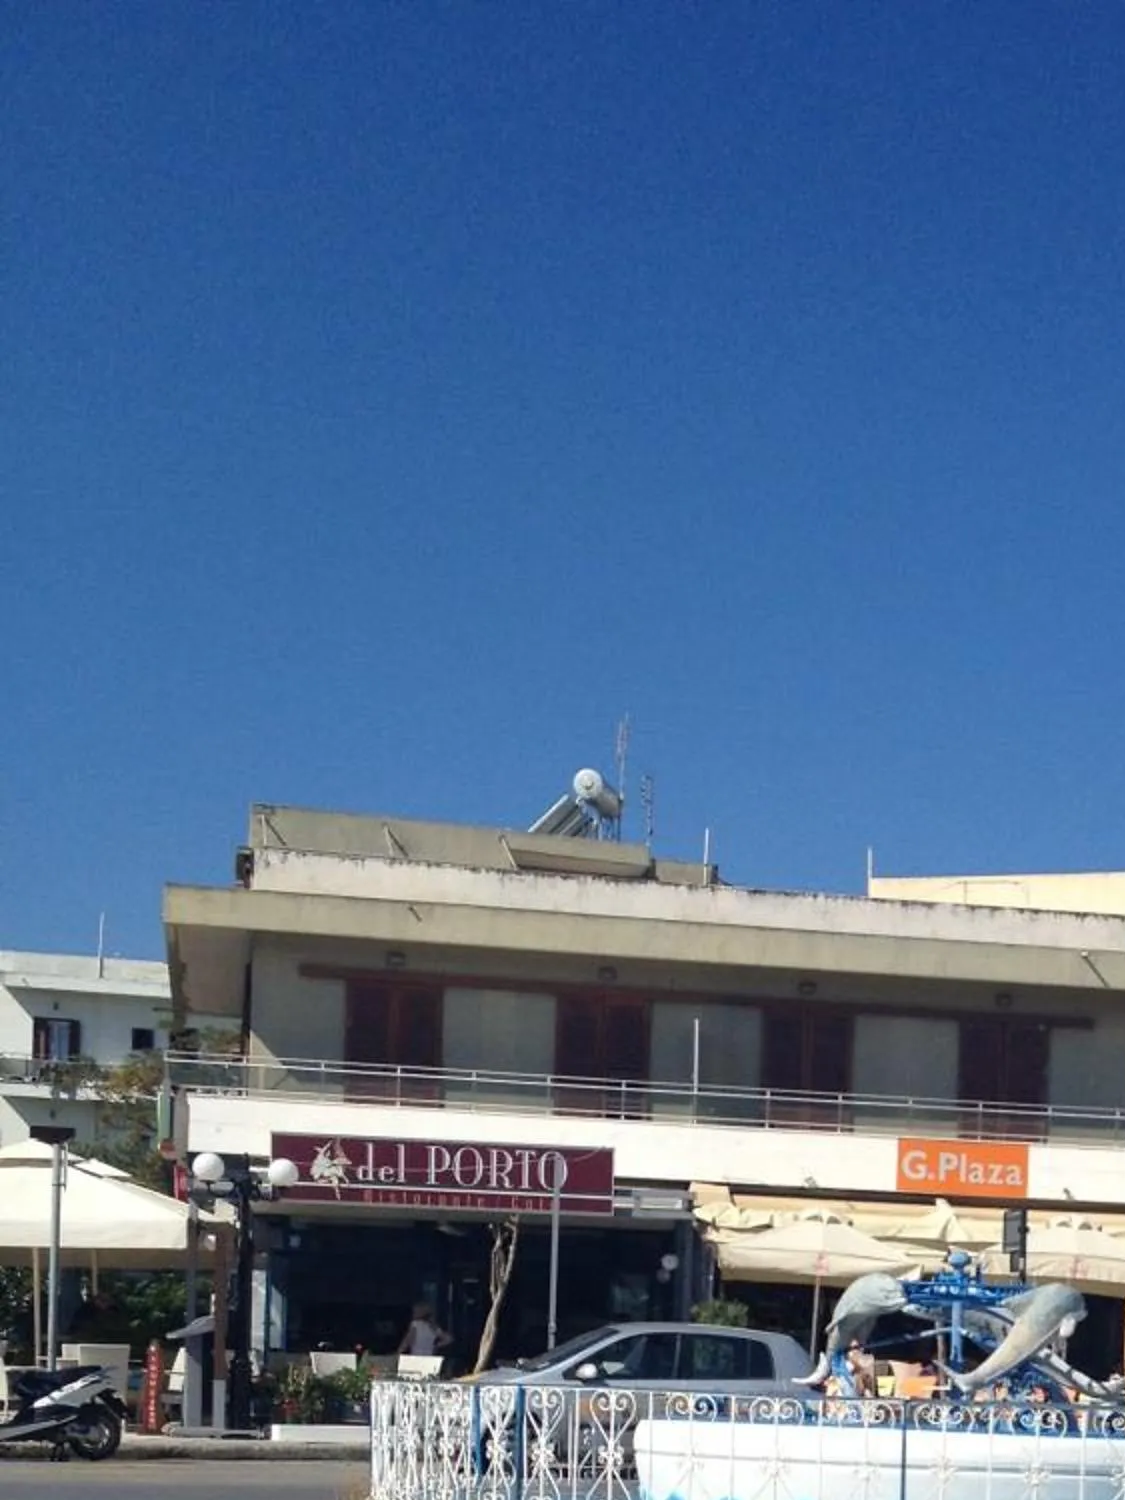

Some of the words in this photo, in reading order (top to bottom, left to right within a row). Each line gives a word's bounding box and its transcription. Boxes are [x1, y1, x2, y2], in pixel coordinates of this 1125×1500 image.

[356, 1142, 405, 1183] del
[424, 1144, 568, 1191] PORTO
[901, 1150, 1023, 1186] G.Plaza
